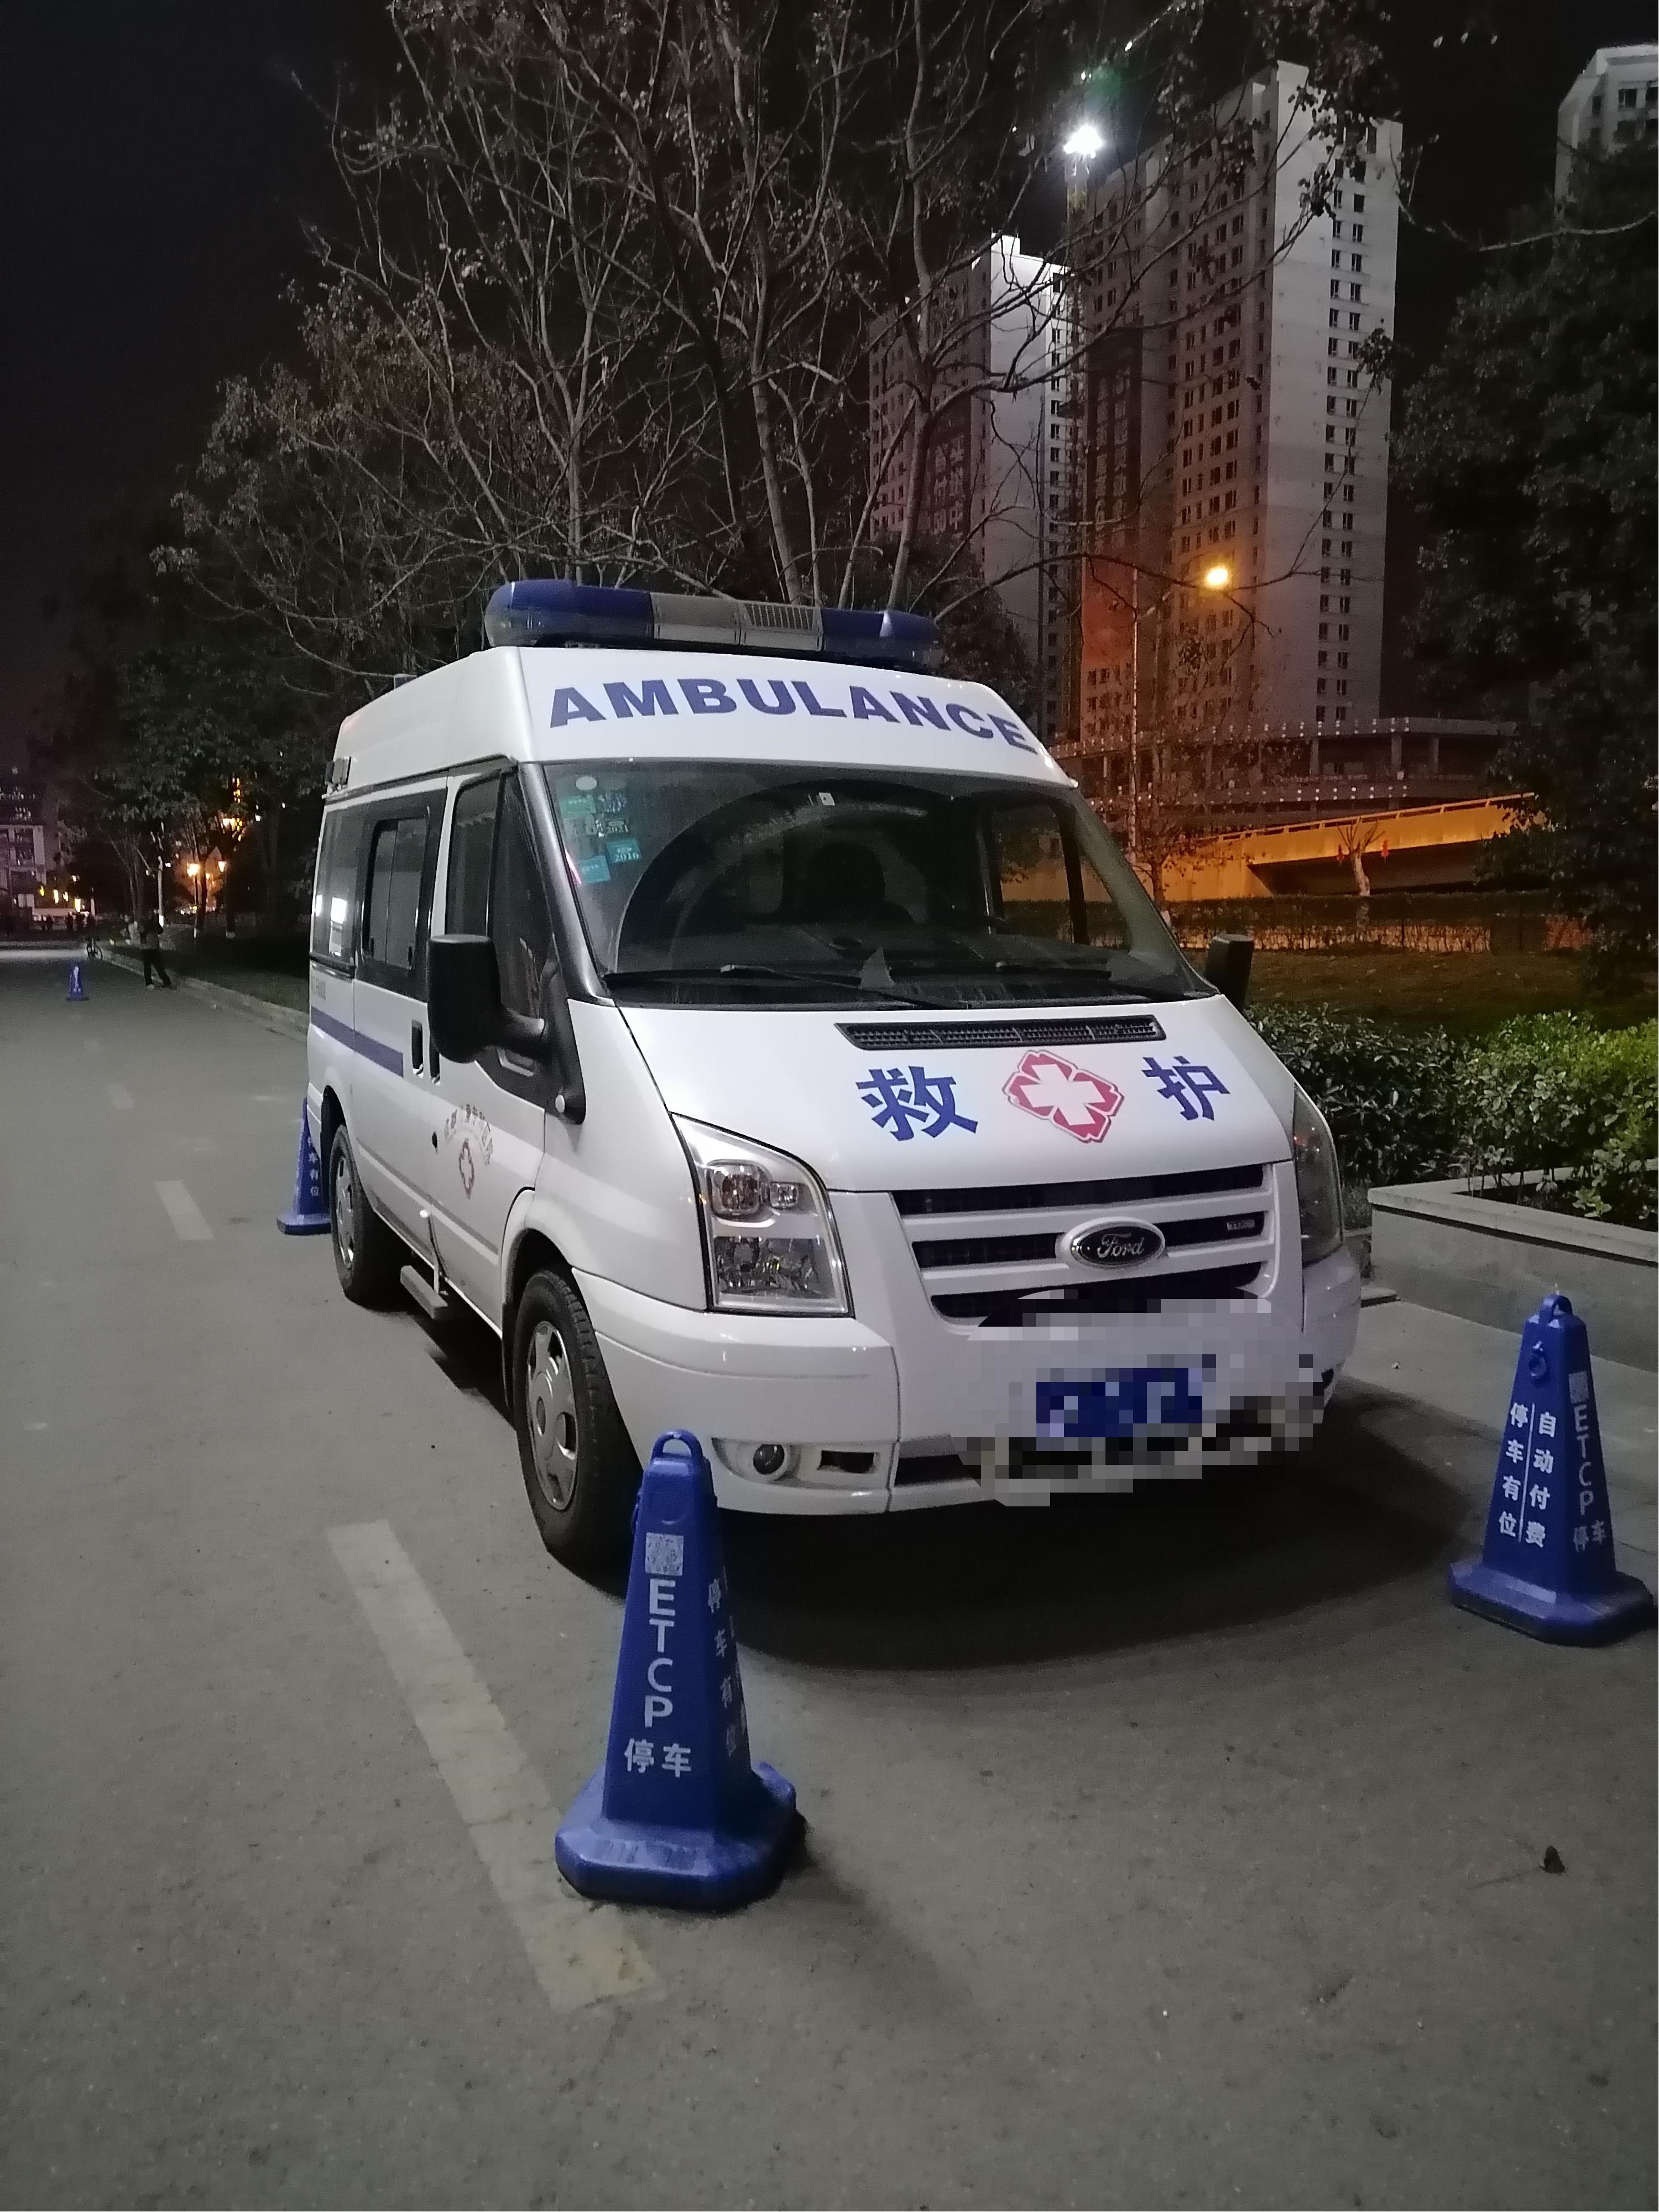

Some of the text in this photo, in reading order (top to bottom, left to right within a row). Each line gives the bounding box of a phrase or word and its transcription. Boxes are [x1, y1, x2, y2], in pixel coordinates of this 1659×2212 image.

[550, 678, 1037, 755] AMBULANCE
[855, 1055, 1230, 1141] 救 护
[1097, 1233, 1146, 1258] Ford
[1499, 1402, 1528, 1538] 停车有位
[1525, 1411, 1557, 1548] 自动付费
[1574, 1405, 1594, 1516] ETCP
[1572, 1521, 1606, 1553] 停车
[644, 1579, 676, 1728] ETCP
[624, 1738, 691, 1778] 停车
